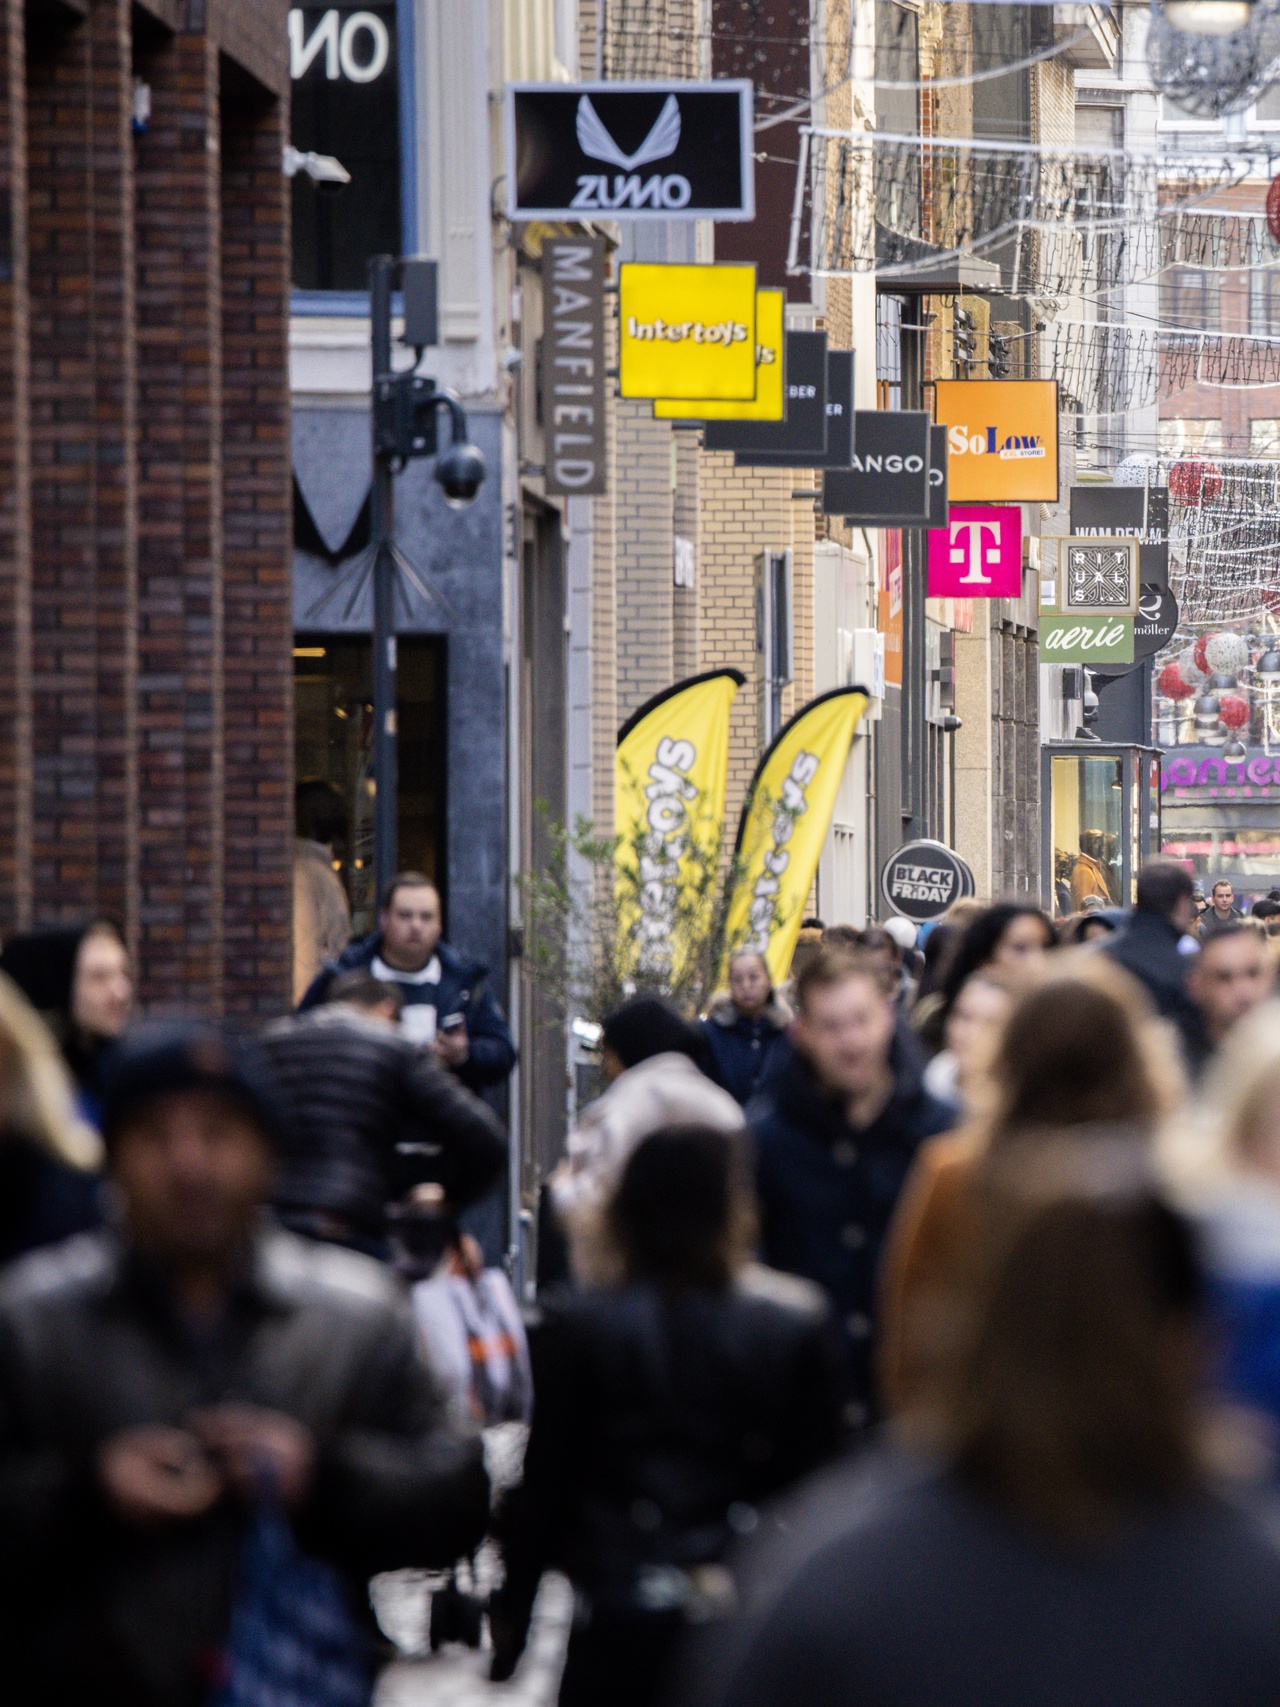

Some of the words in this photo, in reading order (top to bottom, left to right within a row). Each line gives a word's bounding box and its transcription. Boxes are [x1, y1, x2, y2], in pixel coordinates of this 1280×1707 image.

[569, 174, 692, 208] ZUMO
[627, 316, 748, 348] Intertoys
[553, 245, 596, 486] MANFIELD
[949, 425, 1041, 456] SoLow
[1045, 617, 1125, 650] aerie
[896, 867, 952, 887] BLACK
